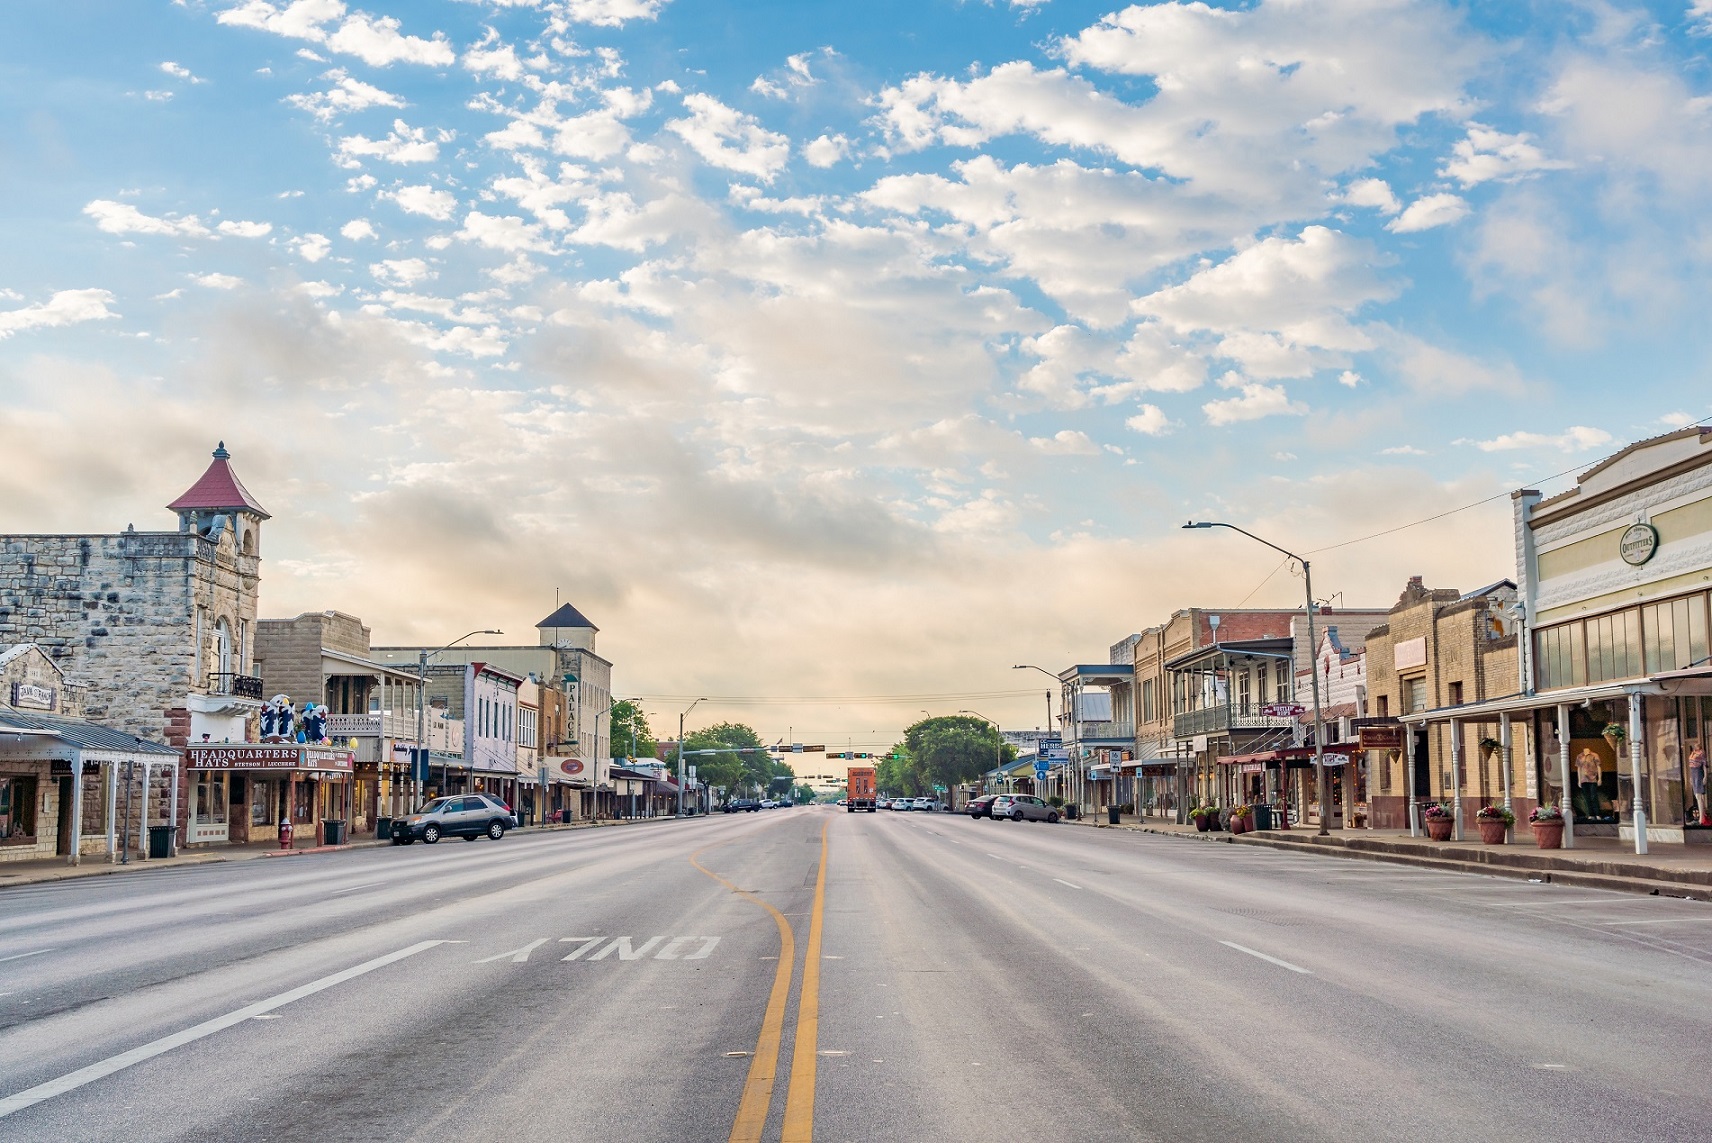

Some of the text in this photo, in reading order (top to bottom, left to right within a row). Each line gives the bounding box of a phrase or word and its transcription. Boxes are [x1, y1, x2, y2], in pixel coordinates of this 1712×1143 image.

[1622, 536, 1653, 553] OUTFITTERS
[567, 684, 576, 739] PALACE
[191, 749, 298, 760] HEADQUARTERS
[195, 758, 229, 767] HATS
[470, 935, 722, 963] ONLY
